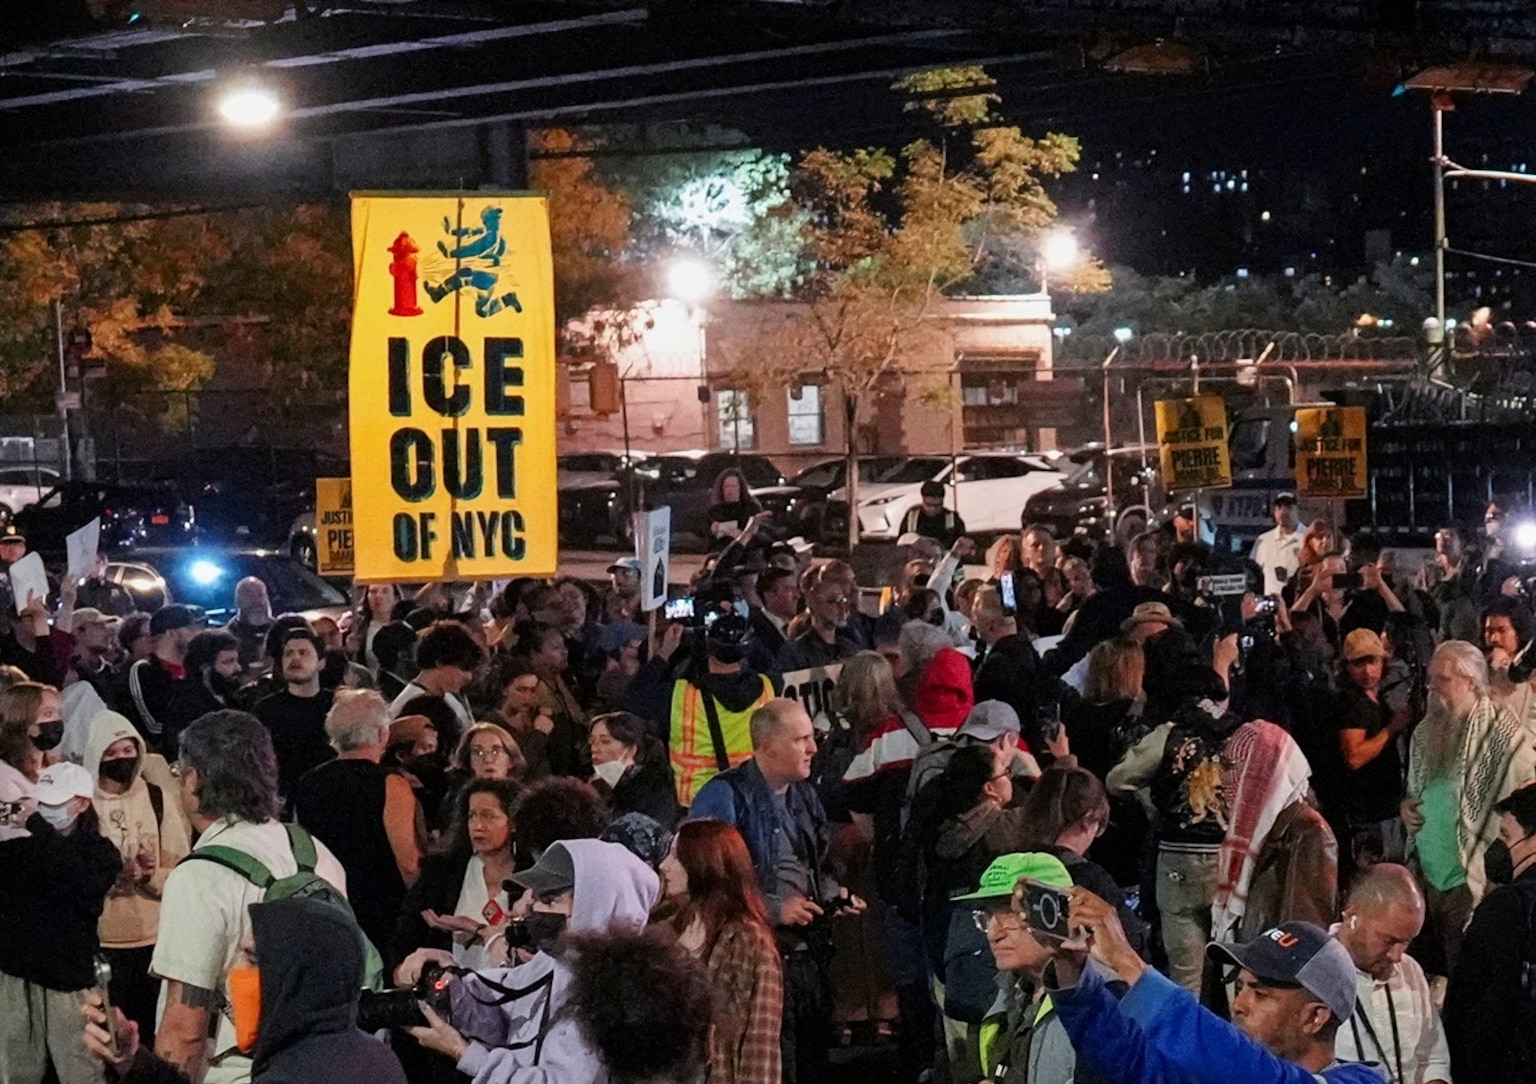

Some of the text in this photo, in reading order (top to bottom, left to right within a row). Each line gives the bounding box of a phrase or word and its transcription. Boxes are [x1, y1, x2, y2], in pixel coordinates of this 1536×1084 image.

[388, 336, 525, 417] ICE
[390, 427, 524, 502] OUT
[1171, 446, 1221, 470] PIERRE
[1307, 457, 1357, 479] PIERRE
[321, 510, 353, 525] JUSTI
[328, 529, 354, 550] PIE
[393, 510, 527, 563] OF NYC
